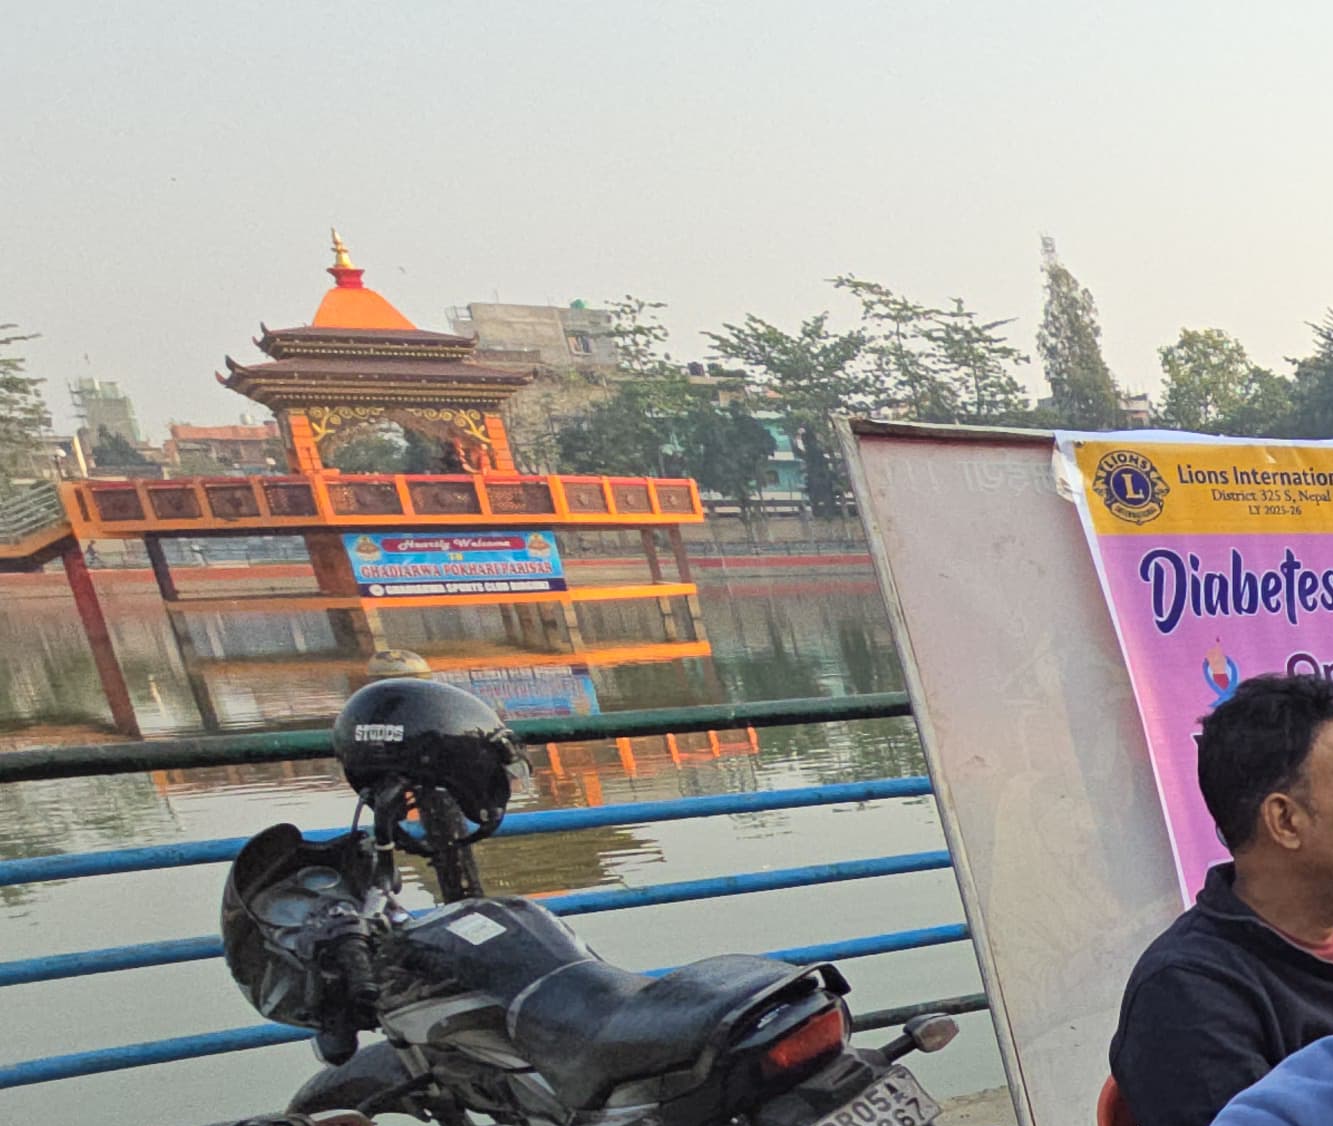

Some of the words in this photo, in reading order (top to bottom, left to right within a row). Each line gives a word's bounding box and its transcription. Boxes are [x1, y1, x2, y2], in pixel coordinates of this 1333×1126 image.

[1177, 464, 1229, 485] Lions
[1211, 489, 1256, 502] District
[1261, 489, 1281, 502] 325
[1284, 489, 1297, 503] S,
[1298, 490, 1331, 506] Nepal
